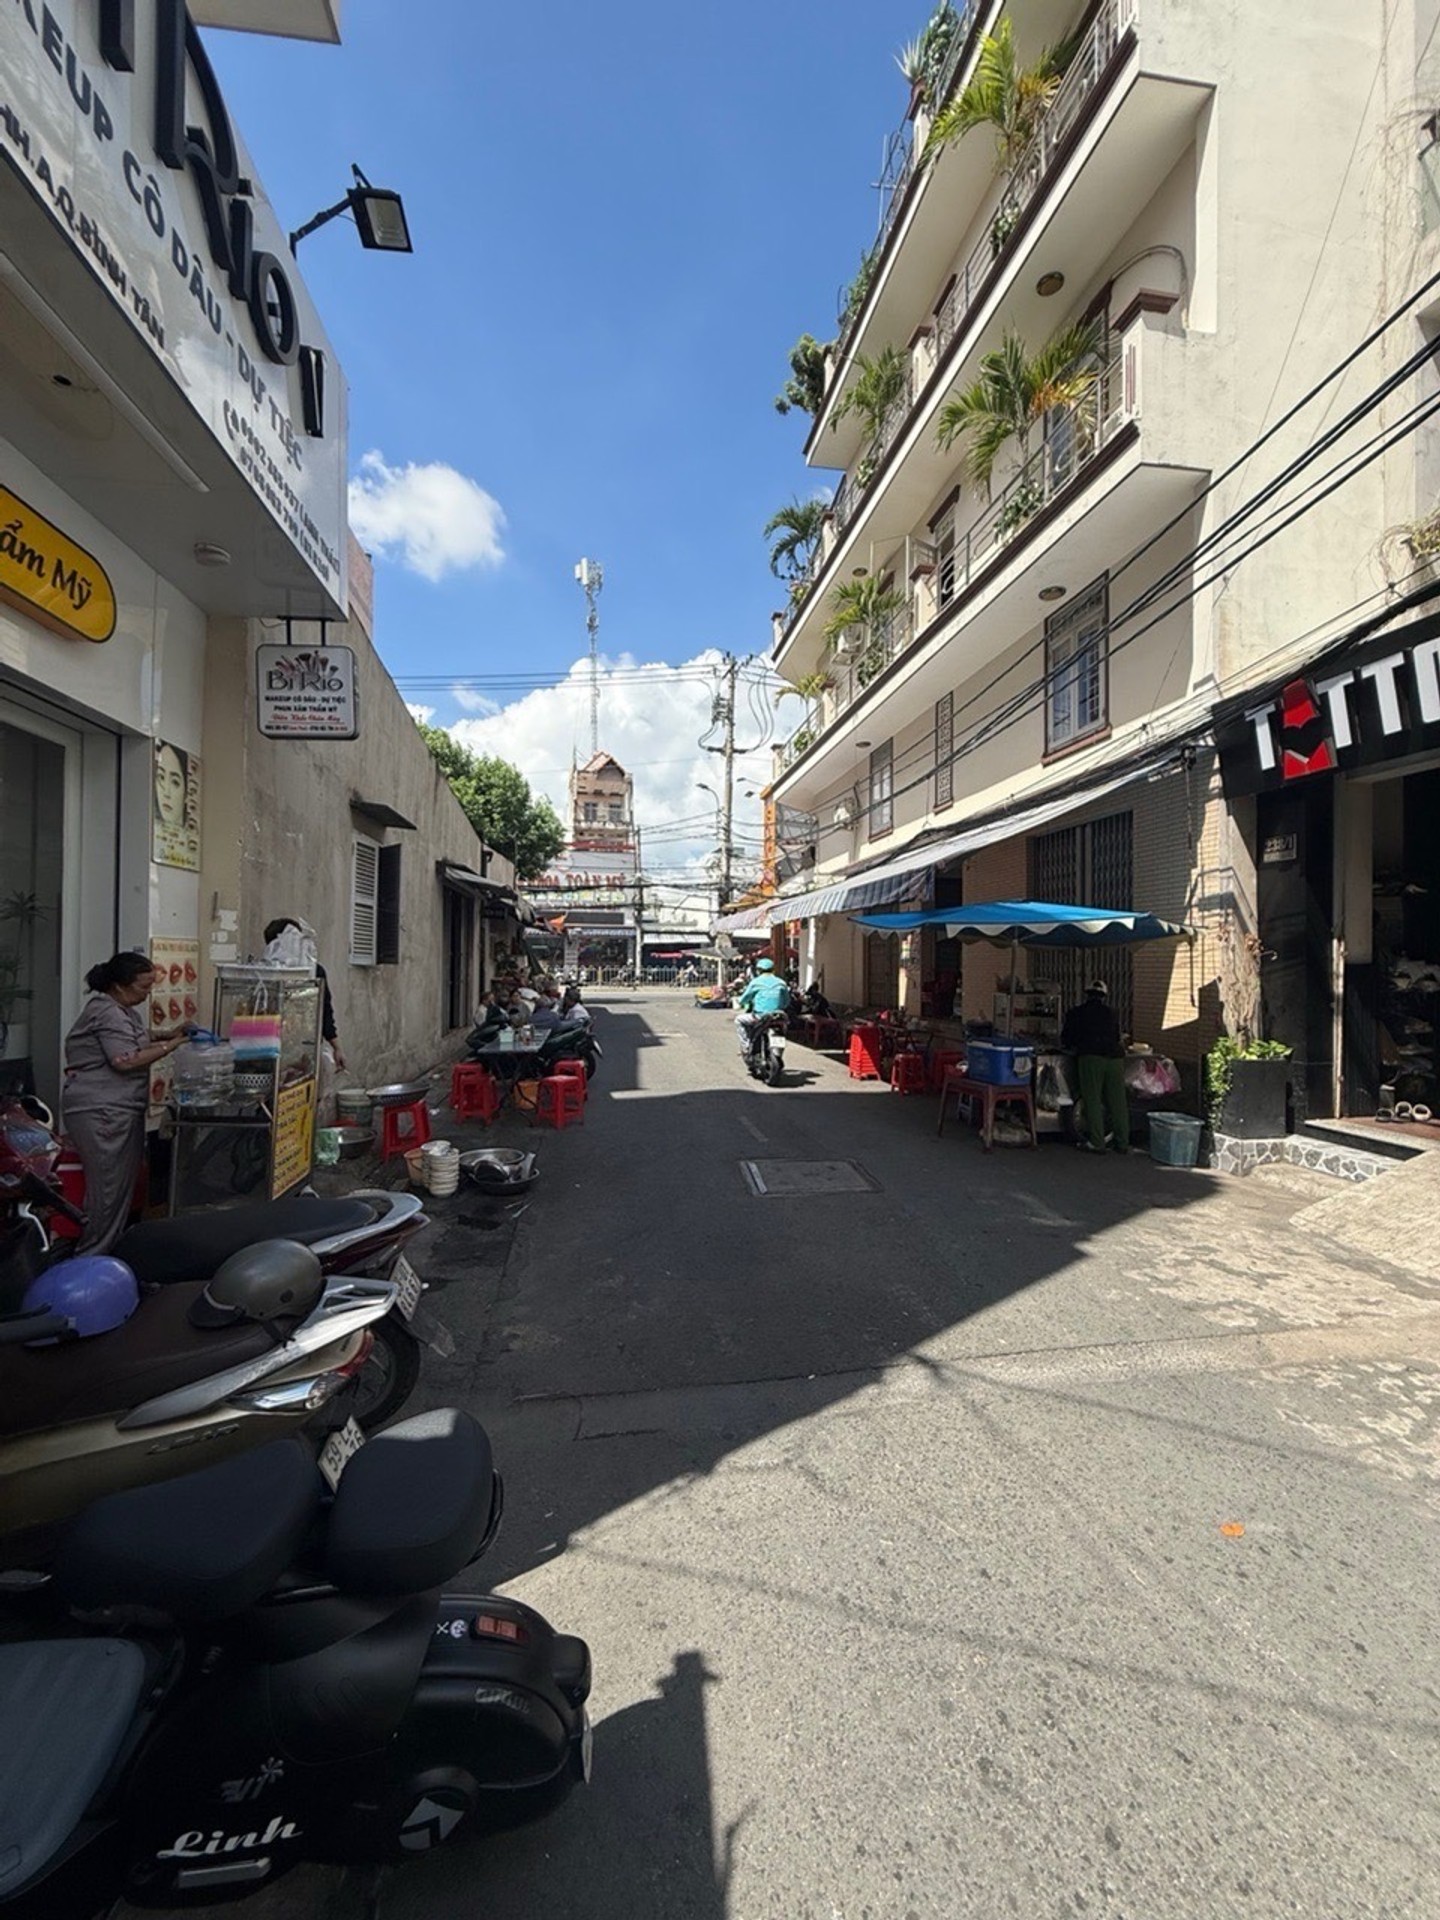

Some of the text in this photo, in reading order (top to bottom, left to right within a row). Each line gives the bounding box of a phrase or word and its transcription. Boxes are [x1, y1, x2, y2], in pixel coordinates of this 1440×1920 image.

[123, 150, 165, 239] CÔ
[172, 226, 224, 336] DÂU
[238, 343, 267, 413] DỰ
[131, 286, 165, 350] TÂN
[51, 557, 93, 610] Mỹ
[156, 1815, 304, 1859] Linh
